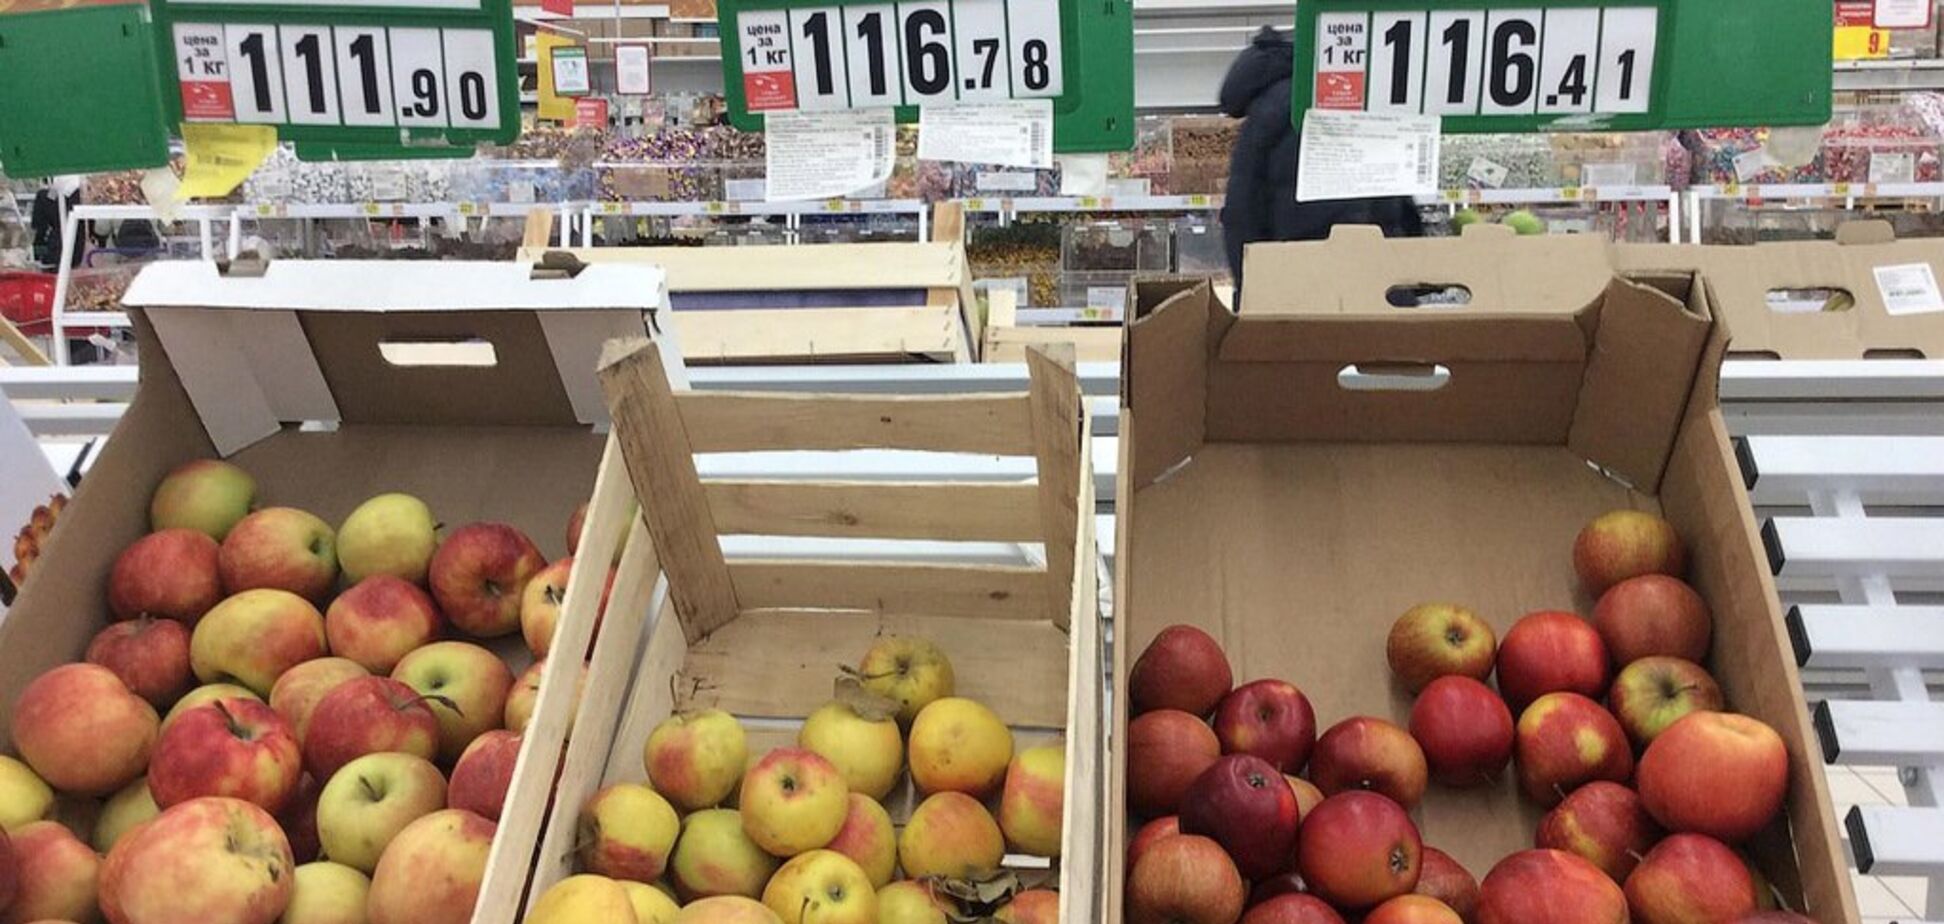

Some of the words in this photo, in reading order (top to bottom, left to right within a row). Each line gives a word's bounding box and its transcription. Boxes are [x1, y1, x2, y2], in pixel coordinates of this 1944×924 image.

[747, 24, 781, 36] цена
[1327, 24, 1364, 35] цена
[183, 35, 218, 46] цена
[757, 37, 773, 47] за
[1336, 36, 1352, 46] за
[194, 47, 210, 57] за
[747, 47, 757, 65] 1
[766, 50, 787, 65] кг
[803, 8, 1050, 95] 116.78
[1323, 46, 1334, 65] 1
[1343, 50, 1366, 64] кг
[184, 57, 195, 74] 1
[203, 60, 225, 75] кг
[1384, 18, 1636, 107] 116.41
[239, 32, 488, 121] 111.90
